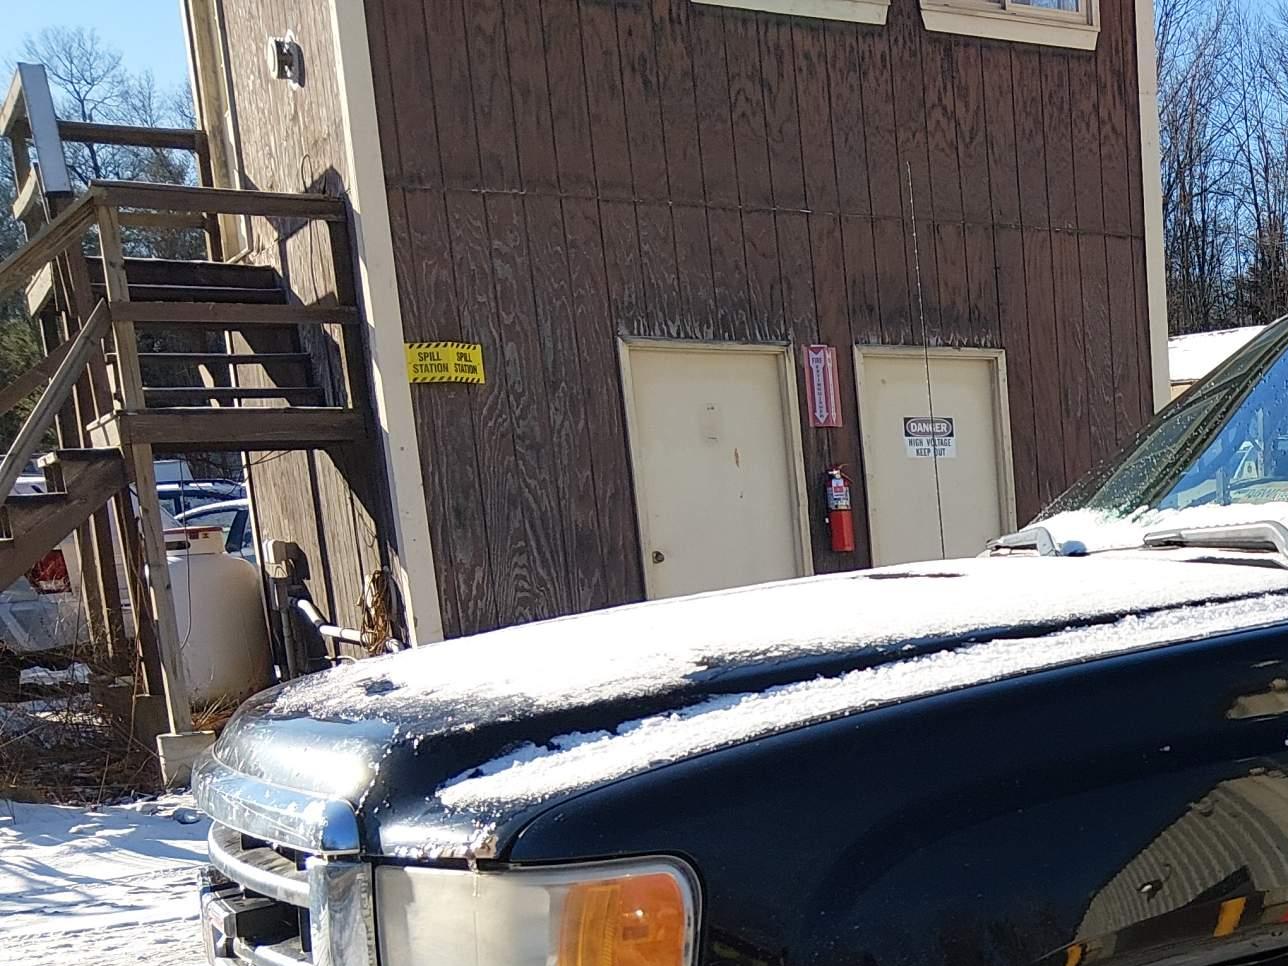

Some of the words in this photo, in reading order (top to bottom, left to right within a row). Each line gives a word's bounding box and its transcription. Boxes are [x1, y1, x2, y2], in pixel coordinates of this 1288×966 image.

[417, 351, 443, 362] SPILL
[456, 352, 472, 362] SPILL
[412, 362, 449, 374] STATION
[454, 362, 478, 375] STATION
[910, 422, 948, 433] DANGER
[908, 438, 924, 447] HIGH
[926, 438, 952, 448] VOLTAGE
[915, 447, 931, 457] KEEP
